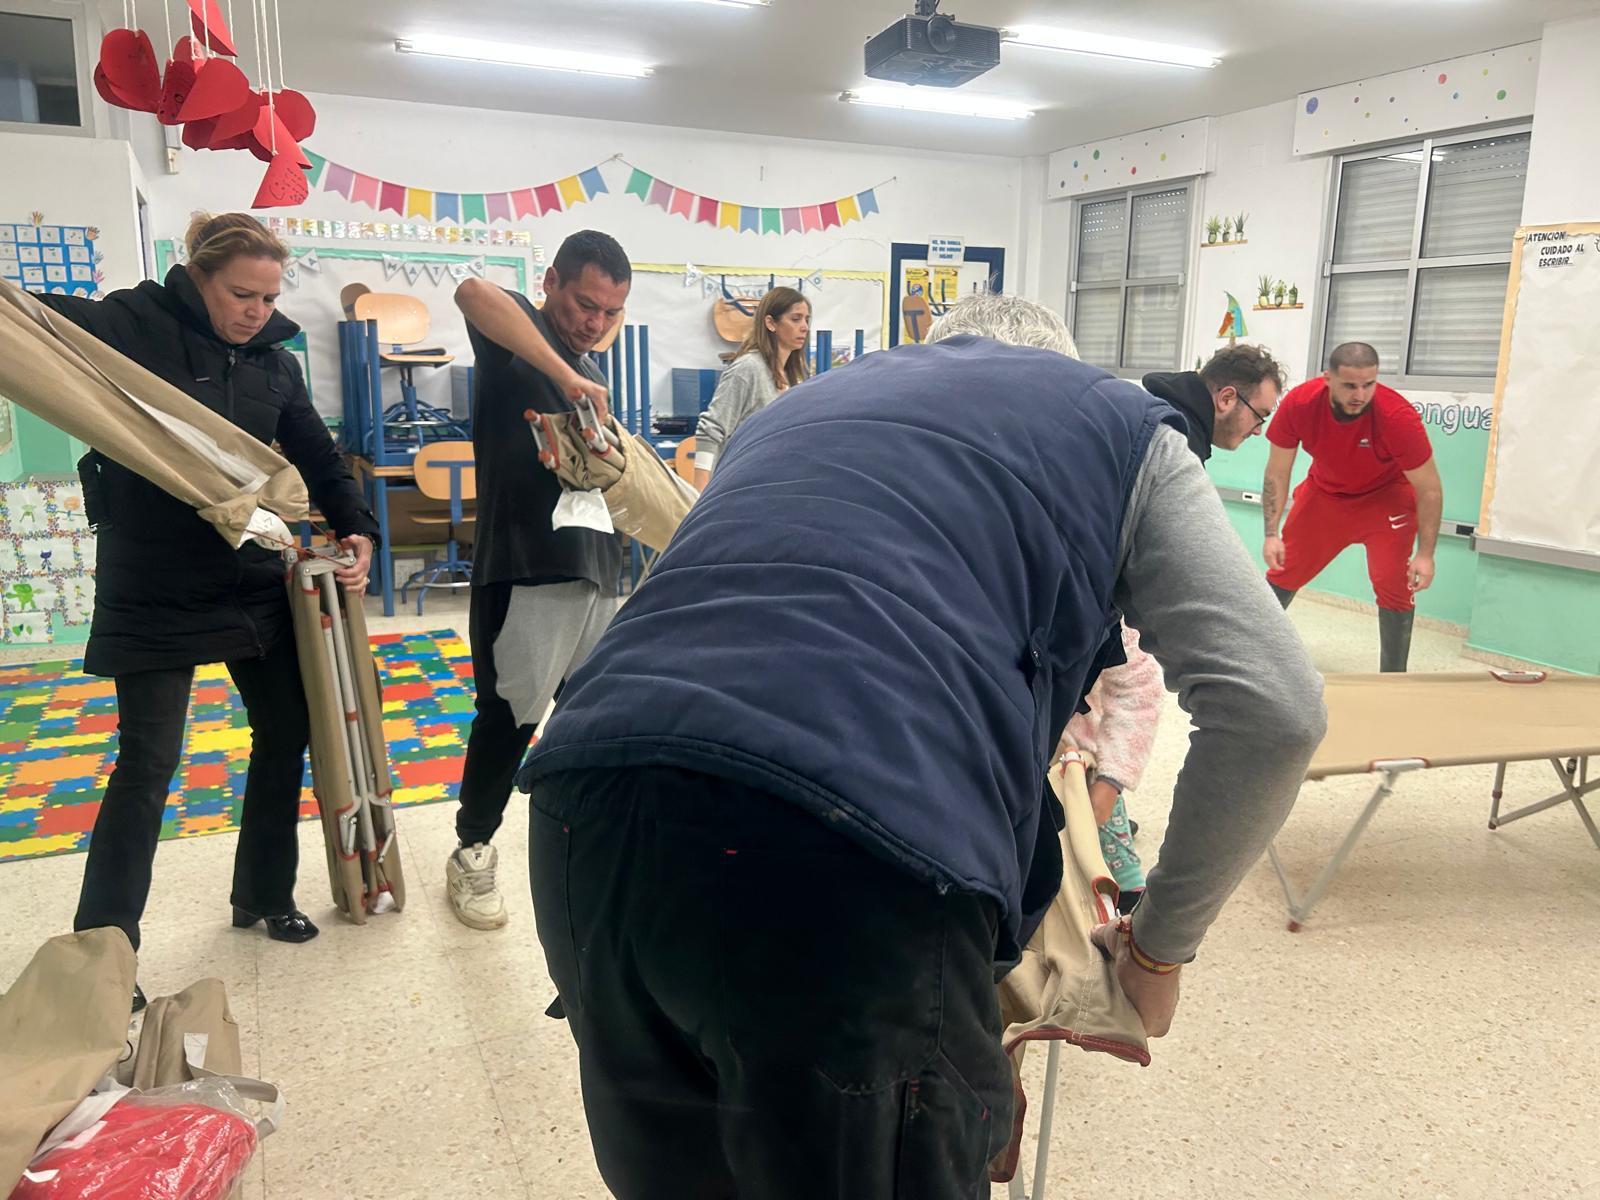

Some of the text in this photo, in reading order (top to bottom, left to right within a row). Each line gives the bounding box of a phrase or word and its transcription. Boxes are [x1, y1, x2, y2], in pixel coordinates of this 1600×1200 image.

[1541, 243, 1584, 255] CUIDADO AL
[387, 261, 483, 276] MATES
[1411, 402, 1494, 435] engua
